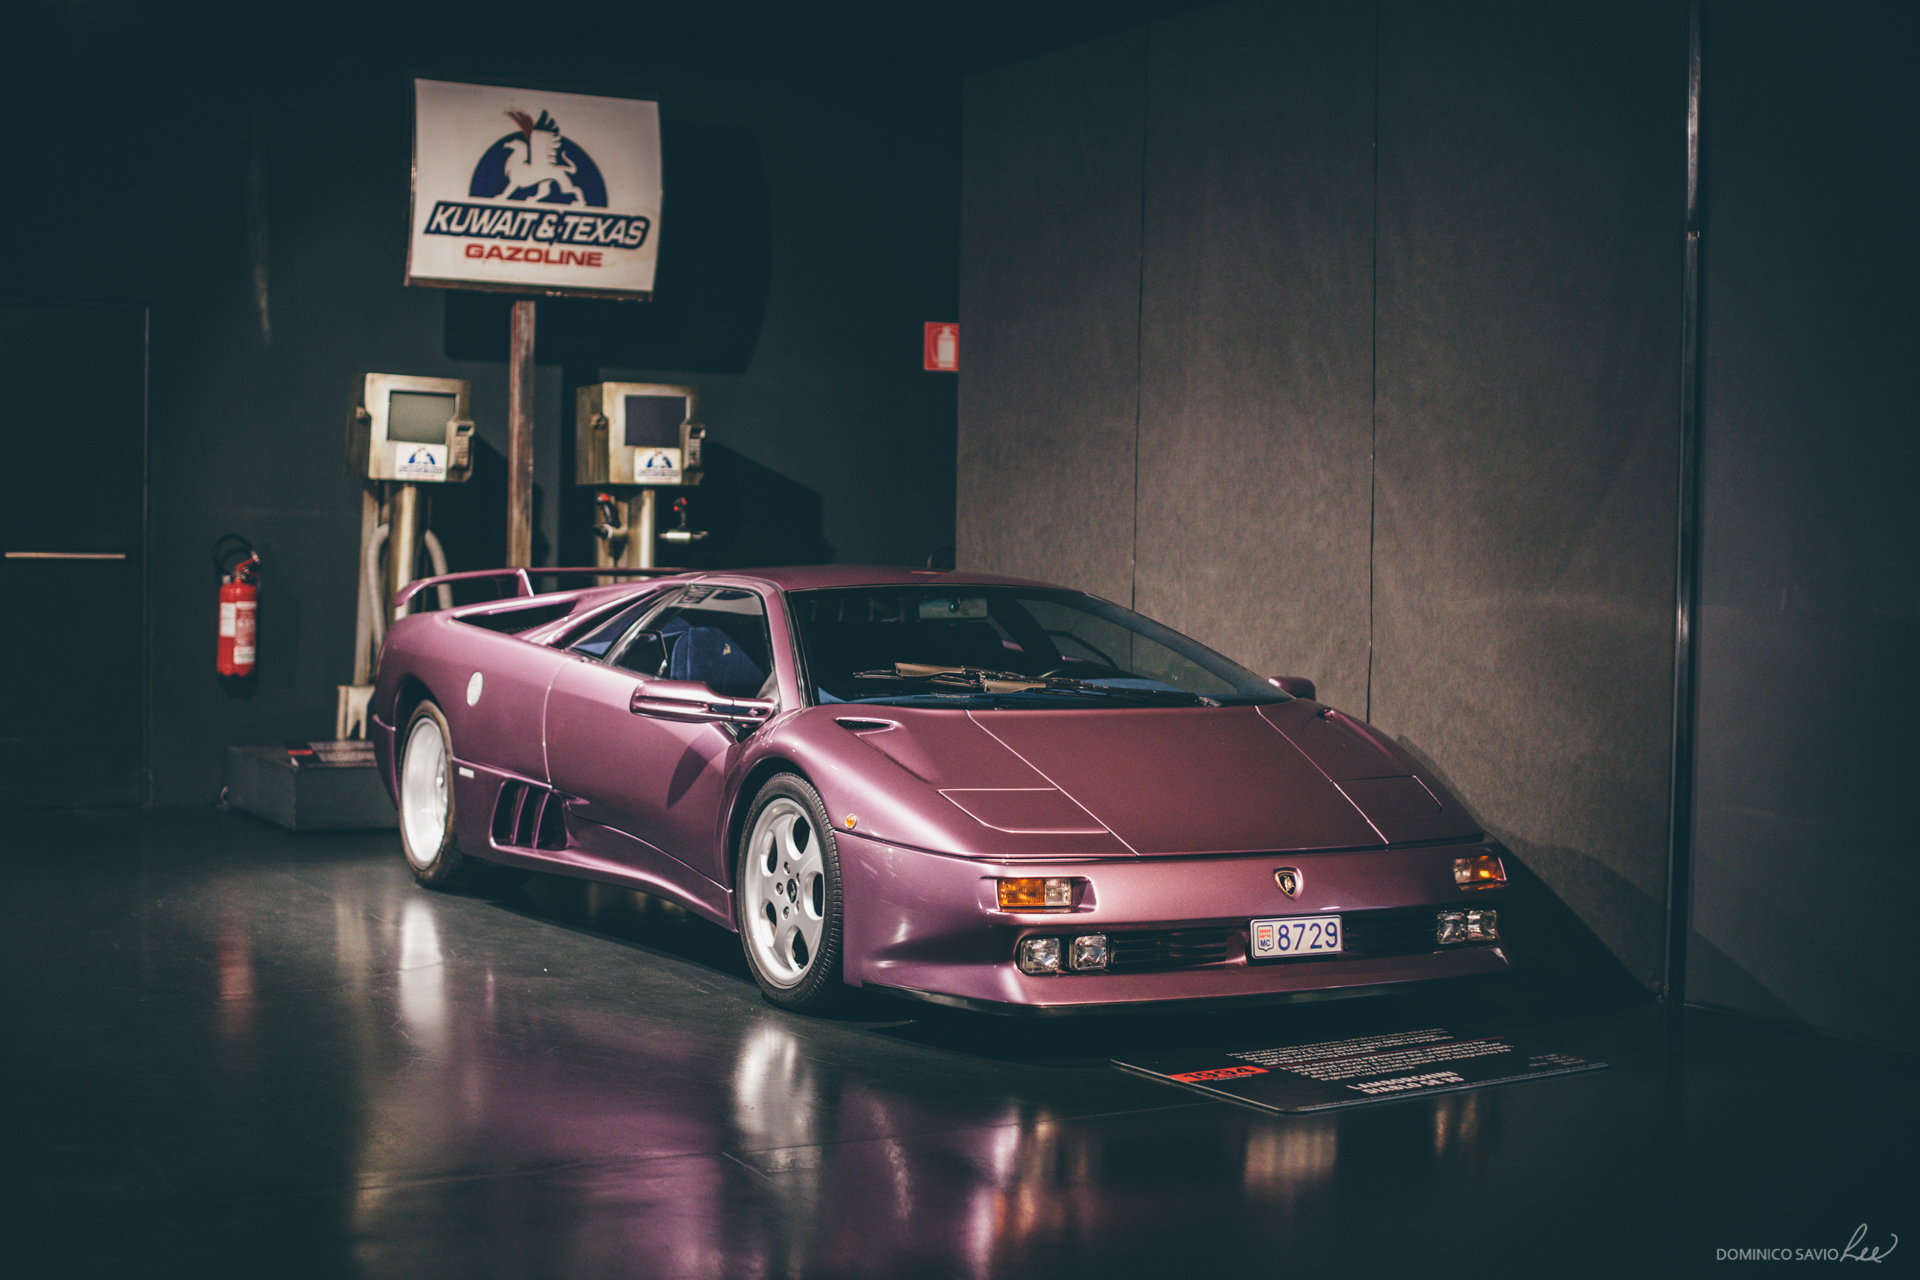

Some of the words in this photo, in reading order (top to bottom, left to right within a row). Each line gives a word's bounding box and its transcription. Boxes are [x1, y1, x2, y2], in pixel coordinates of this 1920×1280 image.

[429, 204, 540, 239] KUWAIT
[535, 210, 558, 240] &
[560, 214, 646, 246] TEXAS
[464, 243, 604, 267] GAZOLINE
[1260, 939, 1271, 947] MC
[1277, 921, 1338, 951] 8729
[1184, 1066, 1255, 1080] 1994
[1346, 1070, 1458, 1090] LAMBORGHINI
[1362, 1081, 1422, 1094] DIABLO
